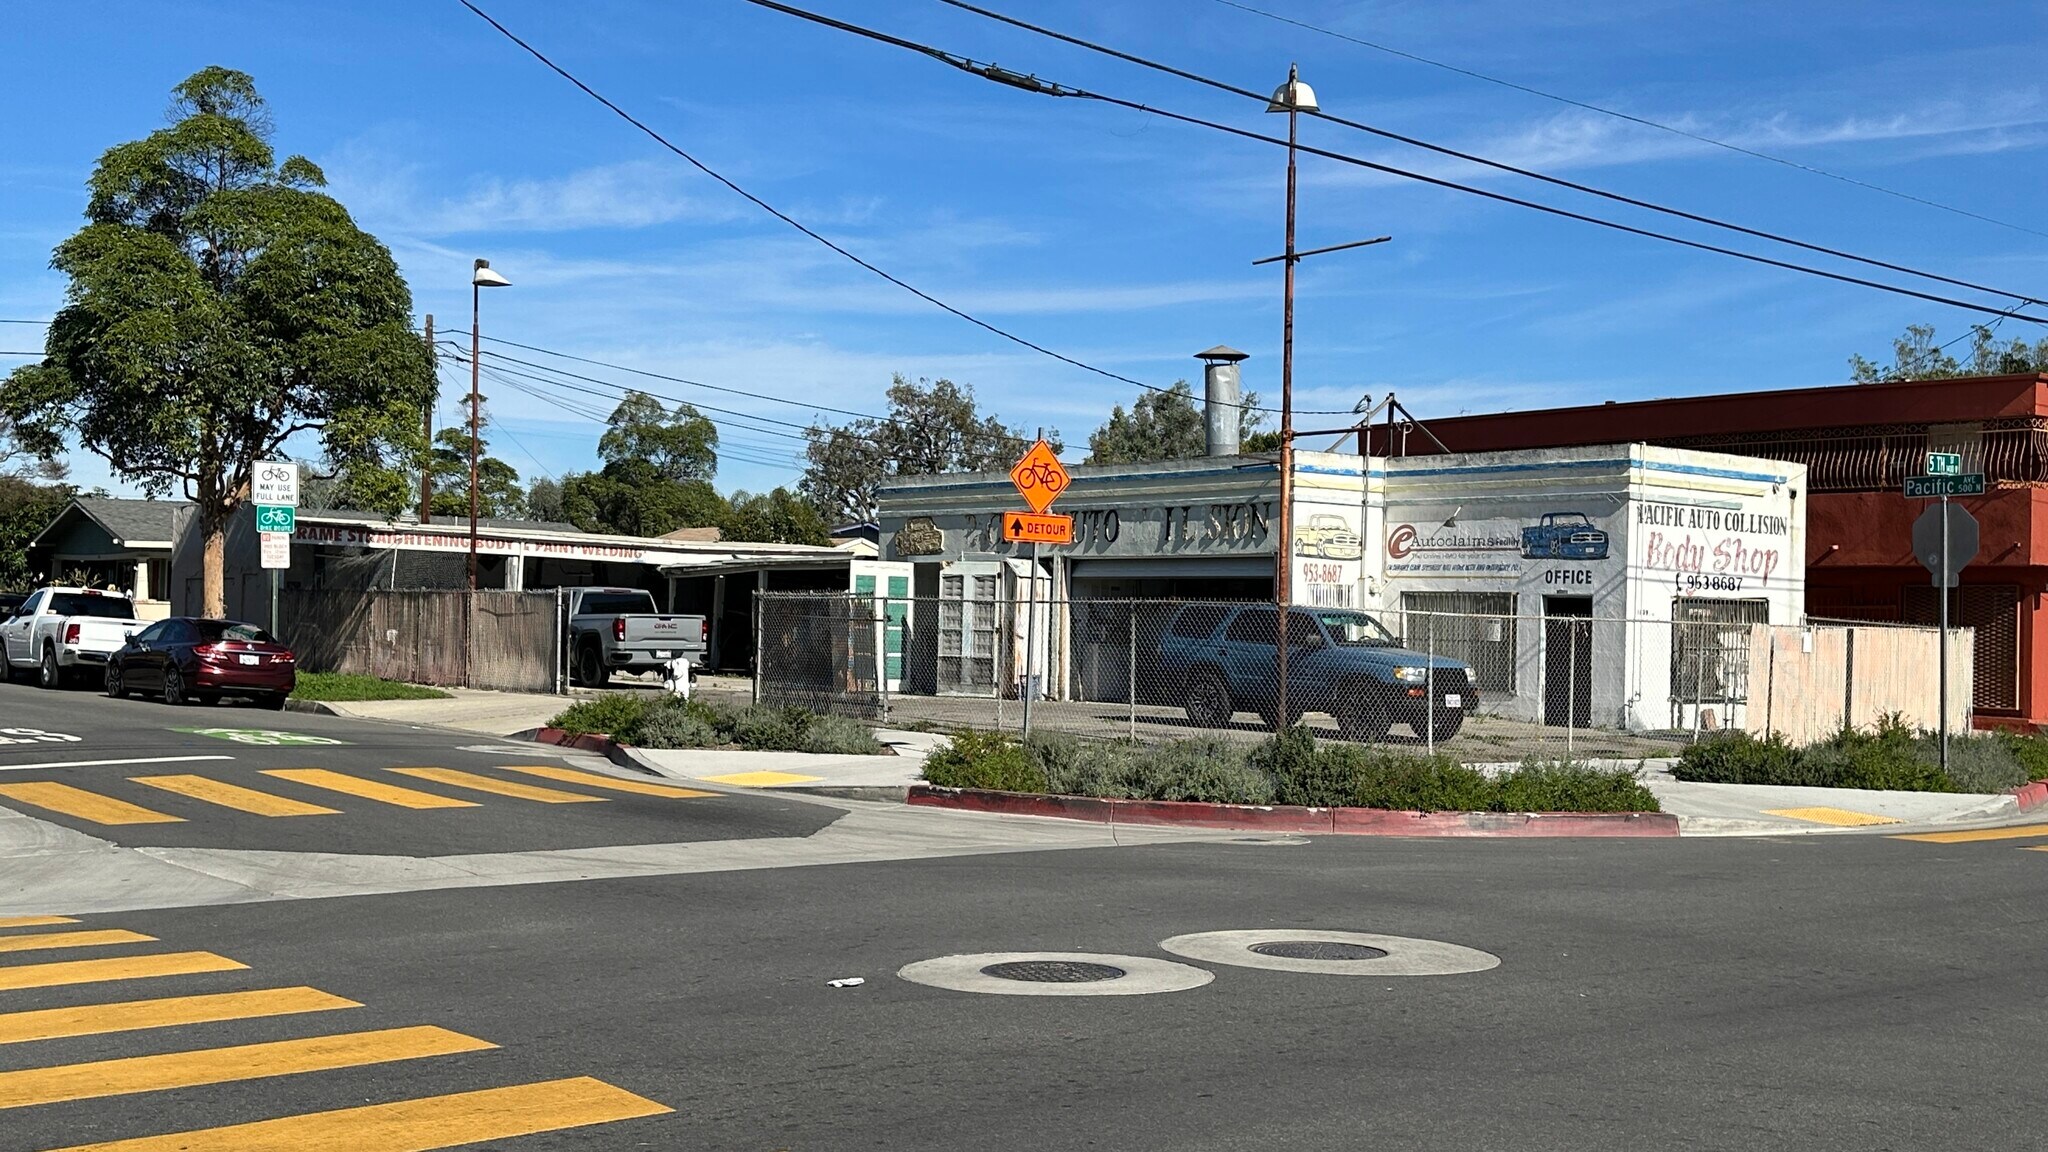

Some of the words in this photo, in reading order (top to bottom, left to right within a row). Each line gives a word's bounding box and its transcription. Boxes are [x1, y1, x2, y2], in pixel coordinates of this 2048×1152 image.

[1906, 478, 1954, 496] Pacific
[1963, 475, 1976, 484] AVE
[259, 483, 274, 491] MAY
[277, 484, 291, 492] USE
[256, 492, 273, 500] FULL
[276, 493, 294, 501] LANE
[1071, 509, 1121, 544] UTO
[1638, 503, 1685, 527] PACIFIC
[1688, 508, 1720, 530] AUTO
[1725, 512, 1787, 535] COLLISION
[1027, 522, 1066, 536] DETOUR
[296, 527, 343, 542] RAME
[347, 529, 469, 548] STRAIGHTENING
[475, 538, 513, 550] BODY
[535, 542, 575, 554] PAINT
[581, 547, 642, 559] WELDING
[1410, 535, 1494, 547] Autoclaims
[1647, 531, 1705, 588] Body
[1713, 538, 1778, 587] Shop
[1545, 569, 1592, 584] OFFICE
